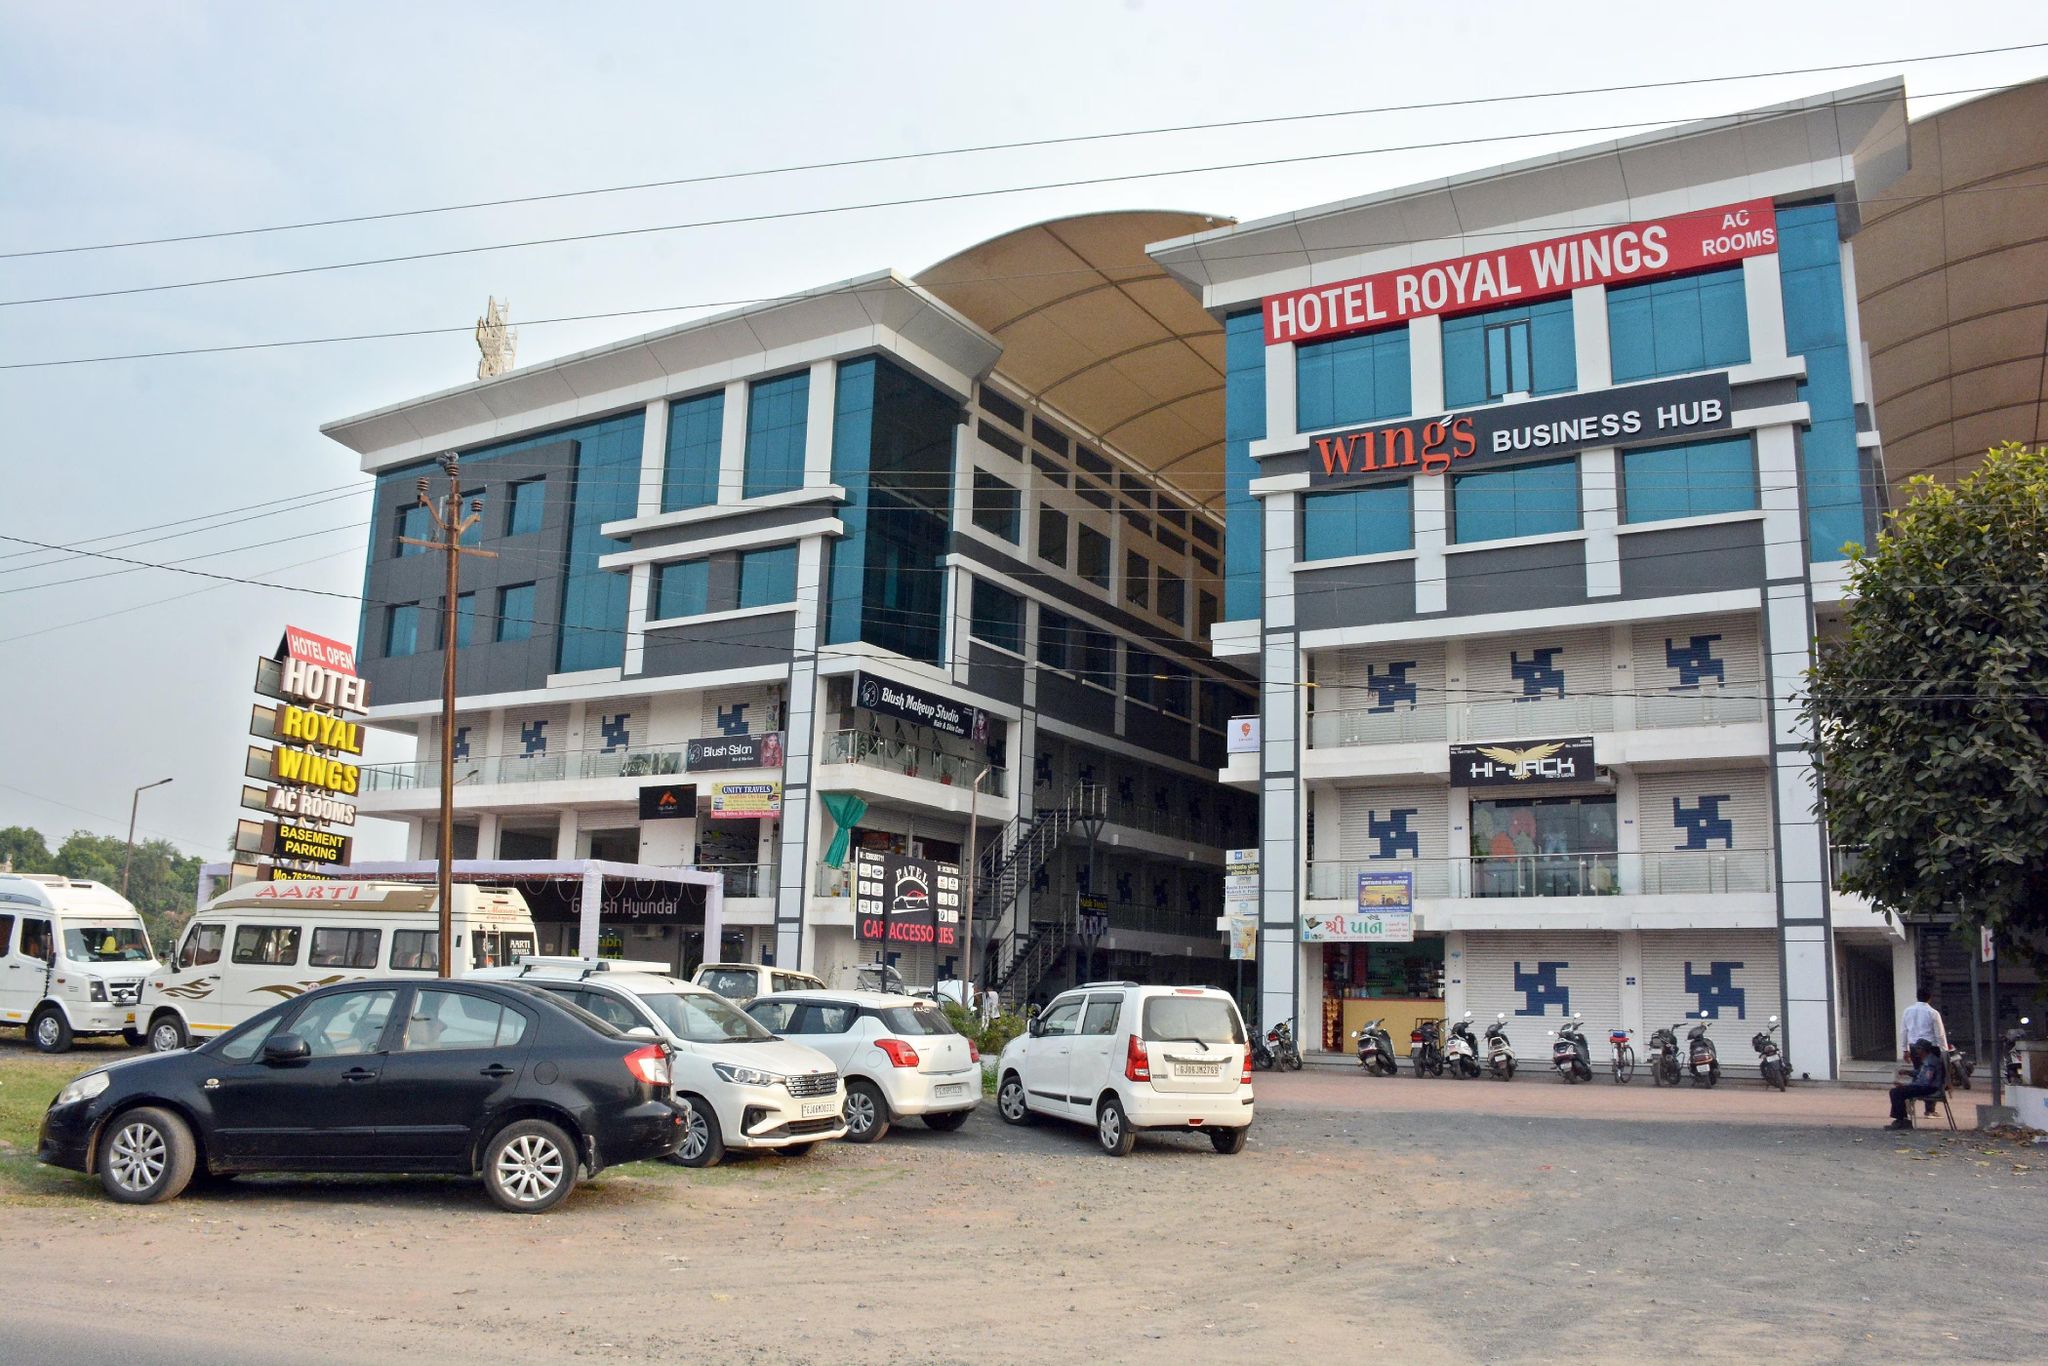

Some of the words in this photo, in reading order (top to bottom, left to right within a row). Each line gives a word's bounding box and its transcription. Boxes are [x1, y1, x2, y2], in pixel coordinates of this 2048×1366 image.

[1721, 209, 1750, 231] AC
[1702, 228, 1775, 257] ROOMS
[1272, 281, 1387, 340] HOTEL
[1396, 255, 1522, 315] ROYAL
[1529, 225, 1669, 289] WINGS
[1492, 409, 1642, 454] BUSINESS
[1657, 399, 1723, 430] HUB
[291, 634, 326, 662] HOTEL
[327, 647, 353, 671] OPEN
[282, 657, 369, 717] HOTEL
[881, 687, 905, 711] Blush
[905, 694, 935, 719] Makeup
[935, 704, 959, 724] Studio
[282, 705, 360, 754] ROYAL
[703, 746, 727, 757] Blush
[728, 744, 752, 756] Salon
[278, 745, 359, 796] WINGS
[1470, 757, 1575, 778] HI-JACK
[723, 786, 742, 794] UNITY
[743, 785, 771, 793] TRAVELS
[272, 789, 296, 812] AC
[300, 795, 356, 826] ROOMS
[280, 825, 345, 848] BASEMENT
[285, 841, 337, 861] PARKING
[895, 865, 929, 886] PATEL
[255, 884, 360, 900] AARTI
[622, 897, 678, 918] Hyundai
[888, 922, 955, 945] ACCESSOIES
[1350, 921, 1383, 934] પાન
[510, 939, 531, 949] AARTI
